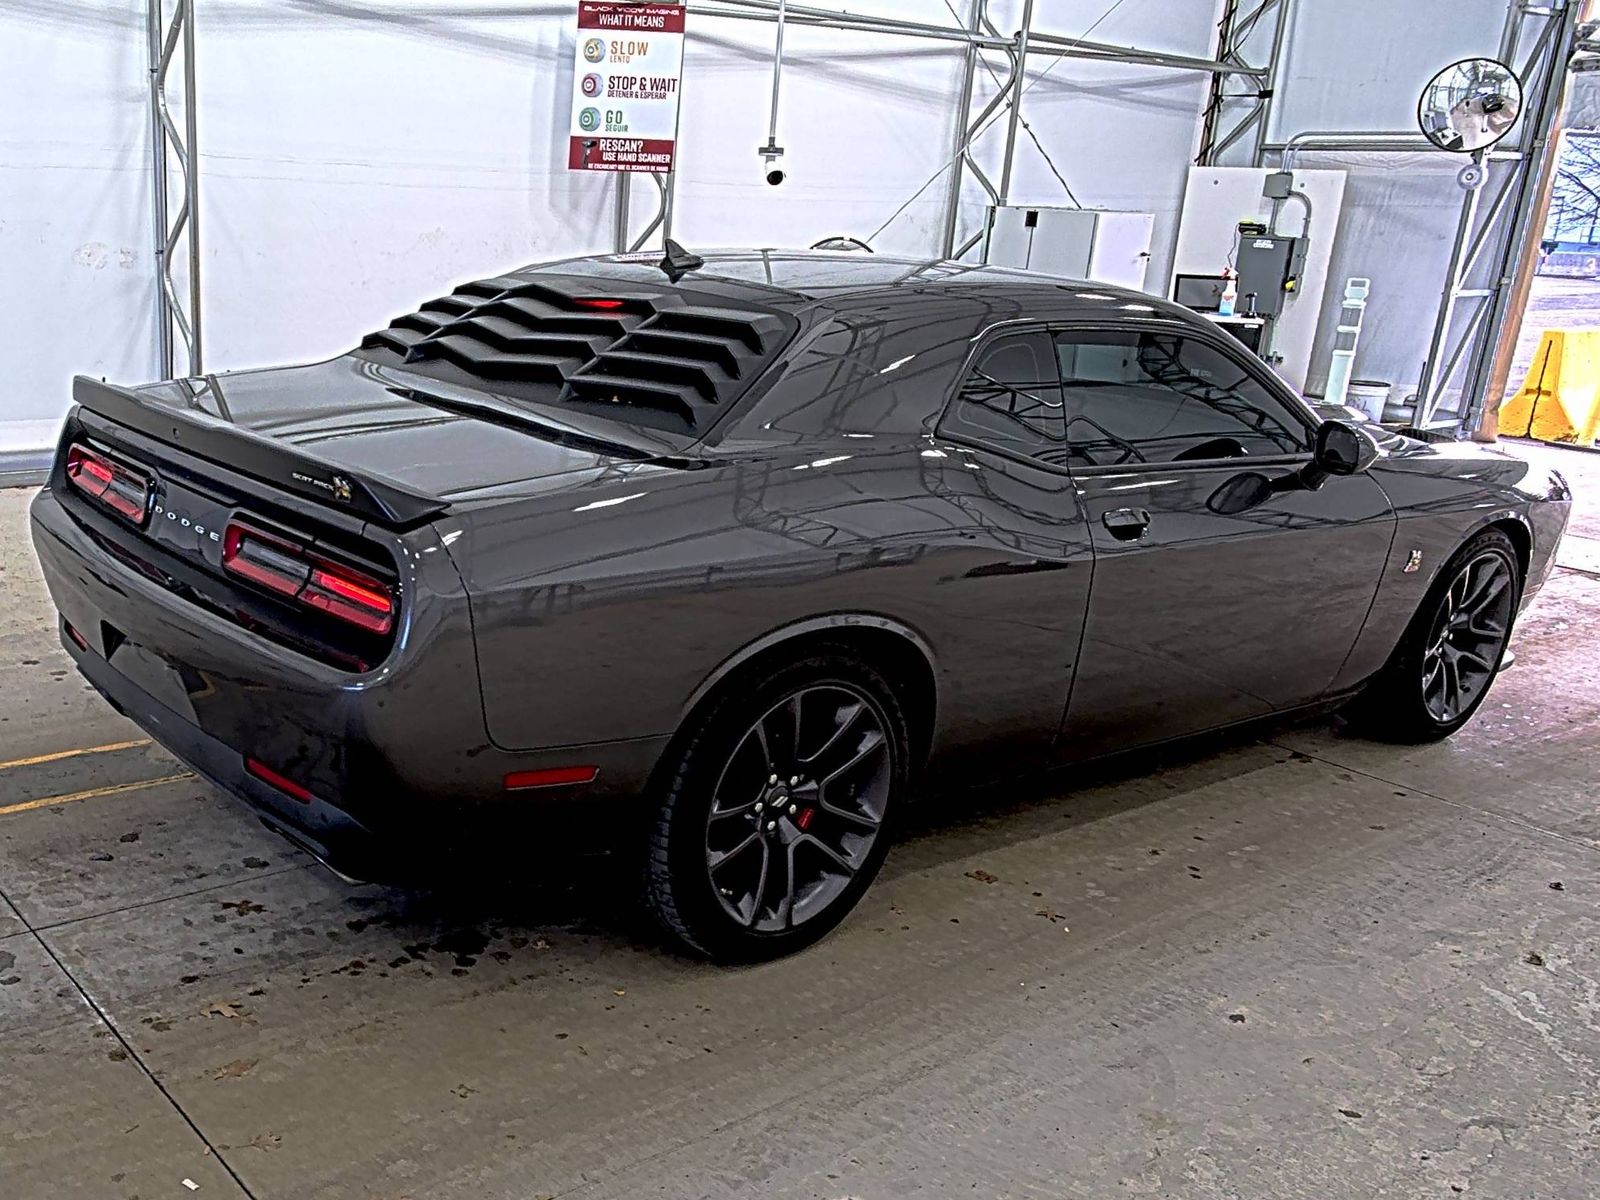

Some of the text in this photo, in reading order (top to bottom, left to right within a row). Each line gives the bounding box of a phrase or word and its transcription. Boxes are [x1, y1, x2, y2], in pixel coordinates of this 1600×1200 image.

[599, 14, 664, 28] WHAT IT MEANS
[610, 41, 649, 56] SLOW
[609, 55, 630, 64] LENTO
[608, 75, 678, 92] STOP & WAIT
[607, 90, 634, 99] DETENER
[640, 91, 667, 100] ESPERAR
[605, 110, 623, 124] GO
[605, 124, 628, 133] SEGUIR
[599, 139, 644, 152] RESCAN?
[602, 152, 671, 164] USE HAND SCANNER
[155, 505, 220, 541] DODGE
